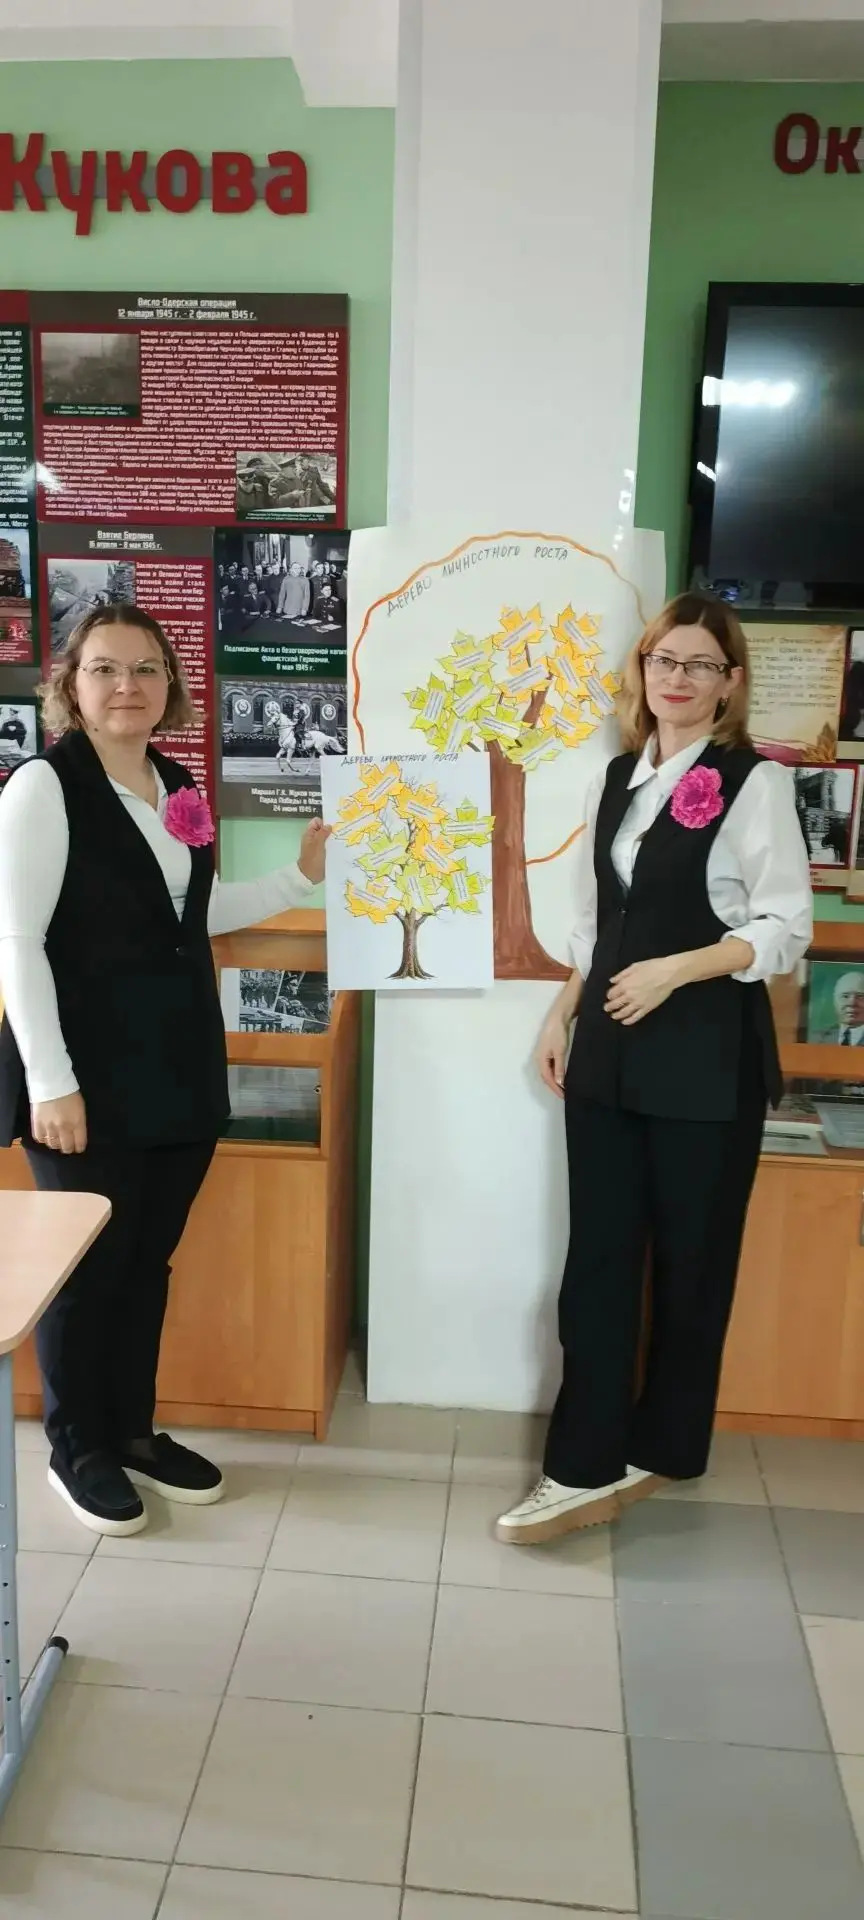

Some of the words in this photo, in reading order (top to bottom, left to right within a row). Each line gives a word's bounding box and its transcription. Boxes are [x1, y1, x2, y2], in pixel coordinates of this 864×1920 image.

[200, 300, 236, 308] операция
[118, 309, 126, 317] 12
[127, 310, 154, 318] января
[156, 309, 172, 318] 1945
[189, 310, 194, 318] 2
[196, 310, 229, 319] февраля
[231, 310, 248, 319] 1945
[97, 530, 122, 538] Взятие
[124, 531, 154, 540] Берлина
[387, 576, 432, 618] ДЕРЕВО
[442, 546, 520, 576] ЛИЧНОСТНОГО
[535, 546, 568, 560] РОСТА
[282, 647, 328, 655] безоговорочной
[341, 756, 374, 766] ДЕРЕВО
[434, 753, 459, 762] РОСТА
